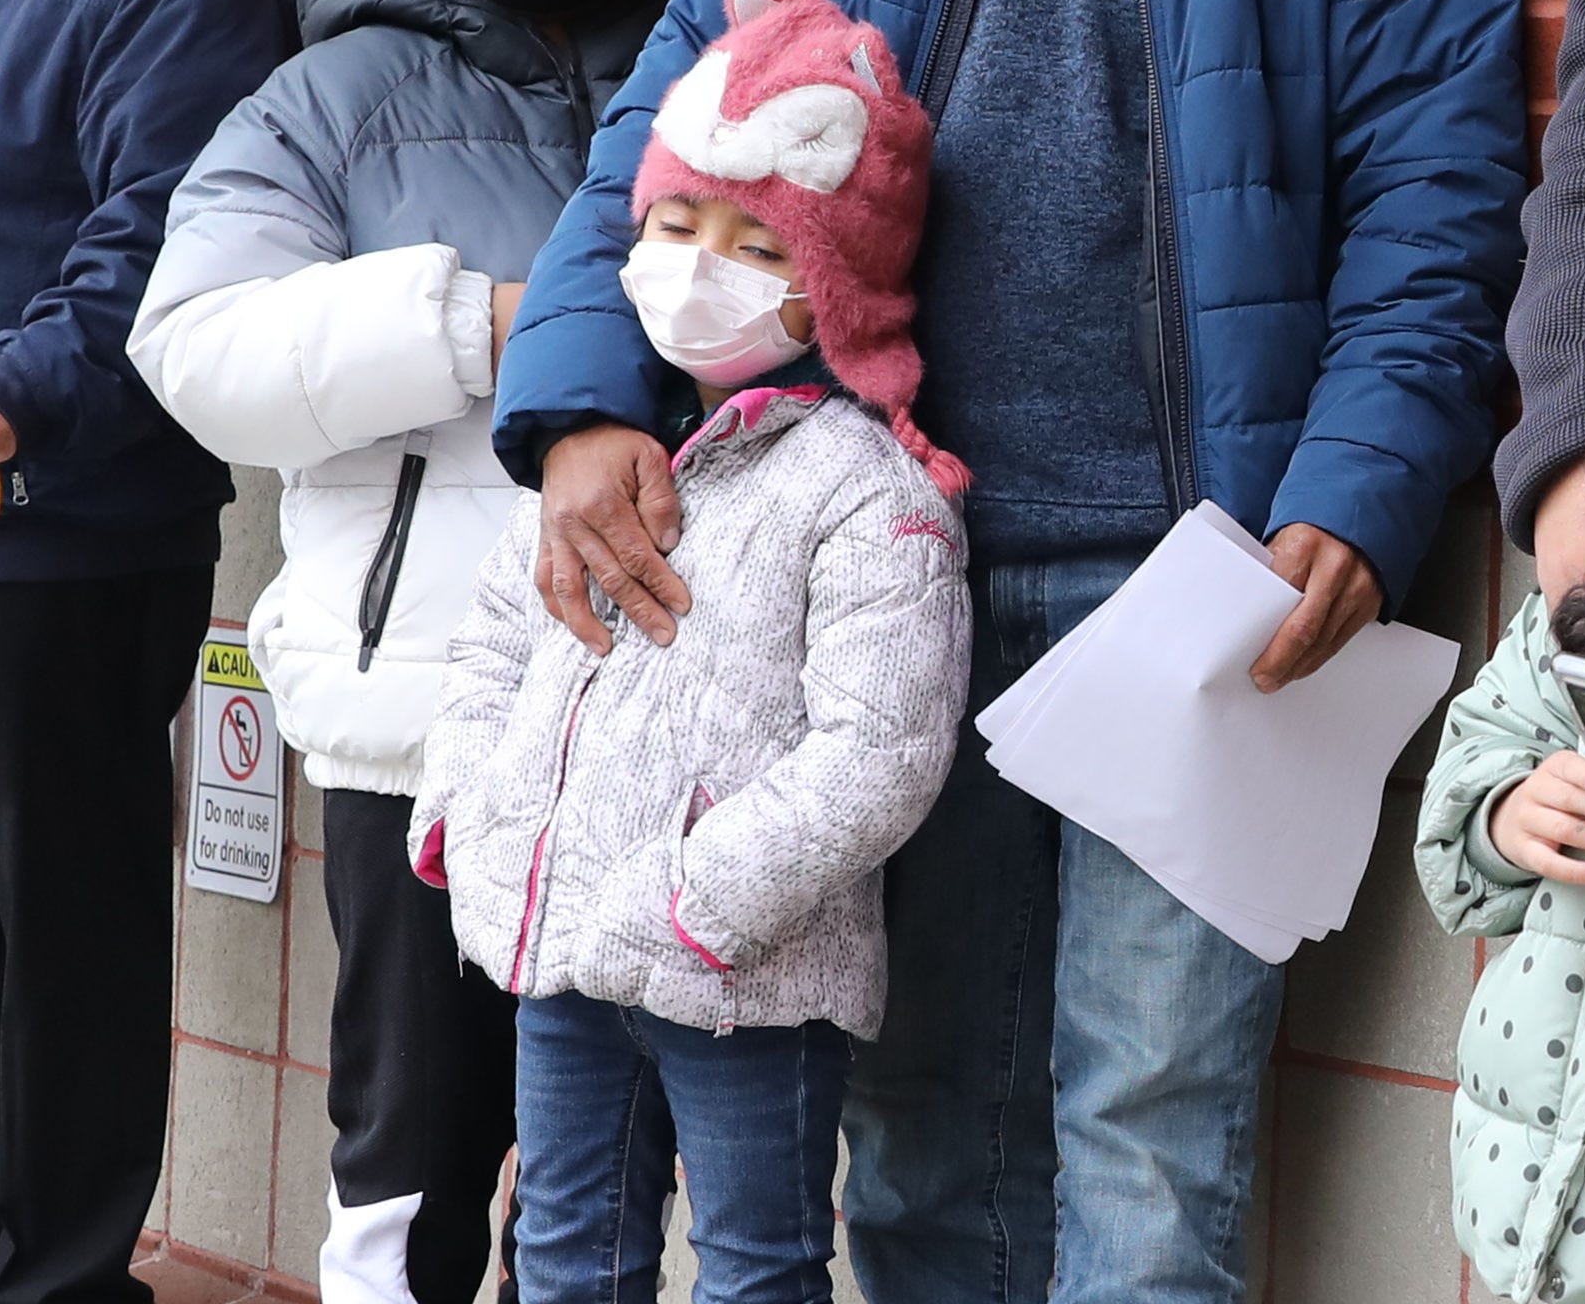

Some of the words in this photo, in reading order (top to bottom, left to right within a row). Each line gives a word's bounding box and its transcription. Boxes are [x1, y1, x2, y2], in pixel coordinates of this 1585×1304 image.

[221, 652, 260, 679] CAUT
[204, 799, 222, 823] Do
[223, 804, 244, 828] not
[248, 811, 270, 833] use
[200, 838, 218, 859] for
[220, 840, 270, 876] drinking
